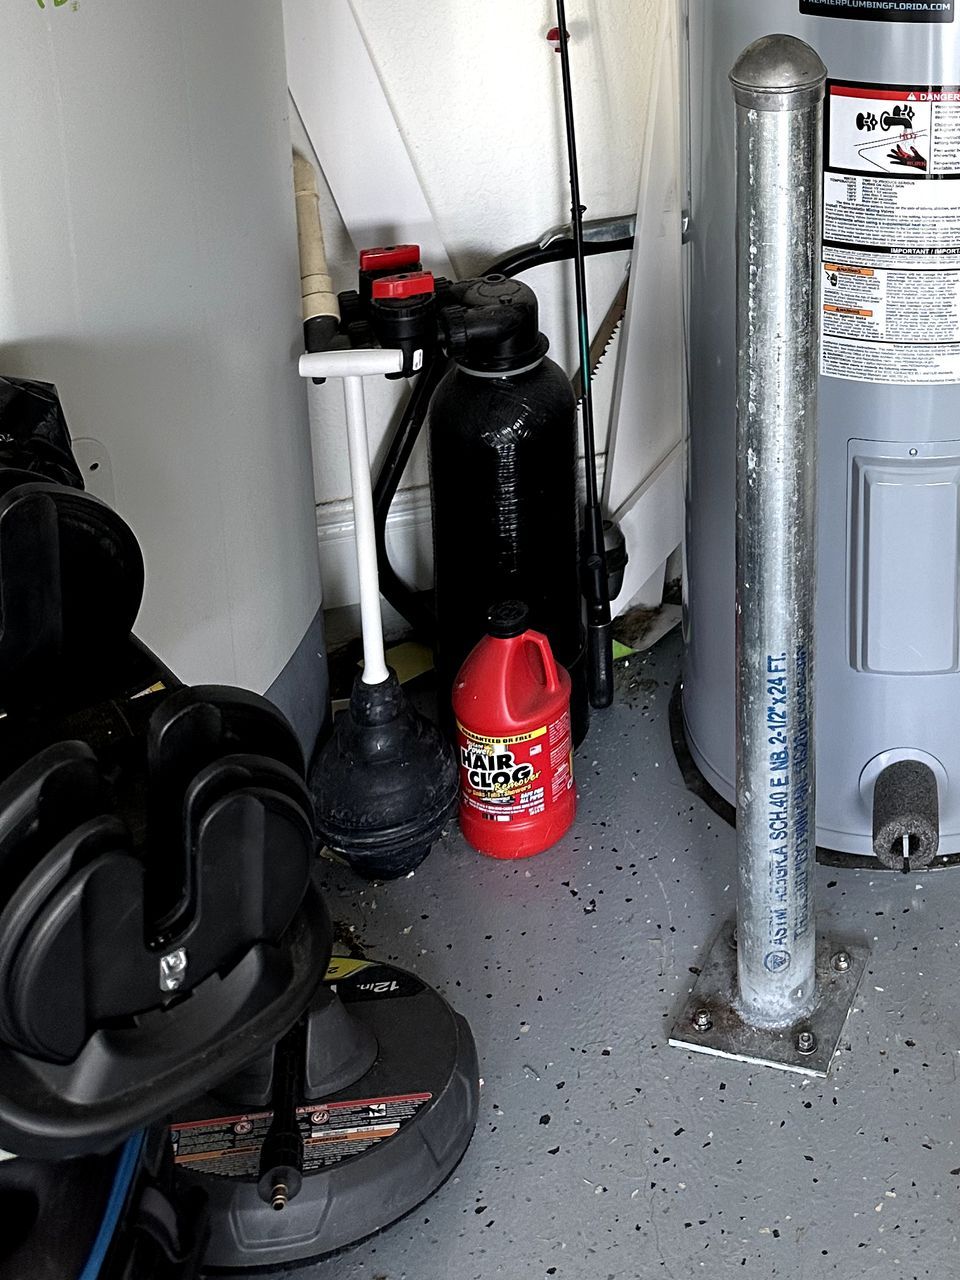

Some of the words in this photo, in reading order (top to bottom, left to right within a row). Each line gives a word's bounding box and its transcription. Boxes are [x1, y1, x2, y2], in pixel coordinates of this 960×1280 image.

[920, 93, 960, 101] DANGER
[767, 652, 788, 673] FT.
[461, 747, 514, 771] HAIR
[468, 763, 533, 790] CLOG
[768, 792, 788, 841] SCH.40
